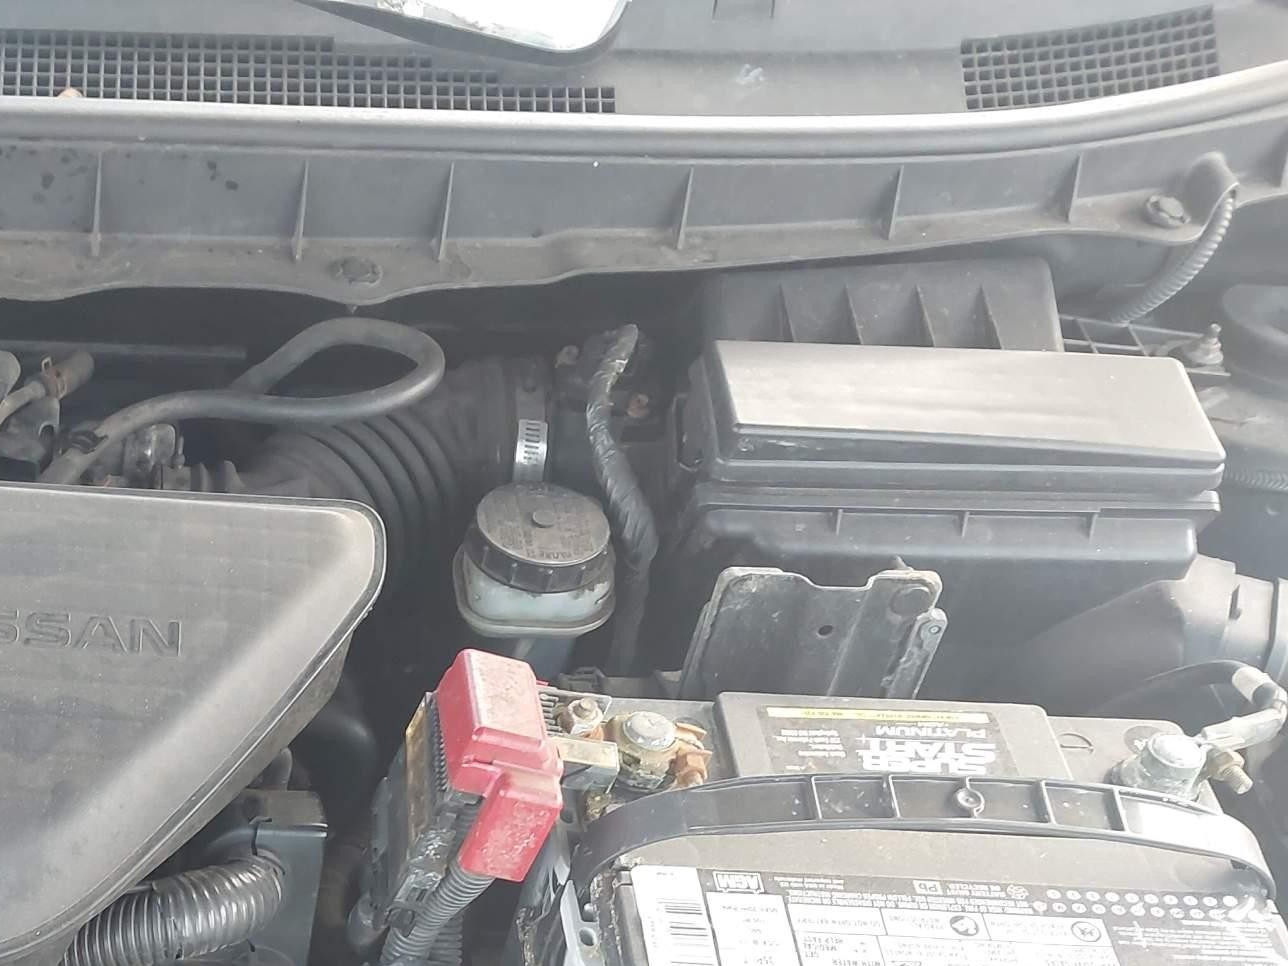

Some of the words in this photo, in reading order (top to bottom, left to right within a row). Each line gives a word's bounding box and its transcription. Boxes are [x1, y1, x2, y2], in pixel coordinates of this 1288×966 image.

[875, 725, 987, 738] PLATINUM
[865, 739, 996, 764] START
[864, 755, 986, 775] SUPER
[918, 882, 937, 892] Pb
